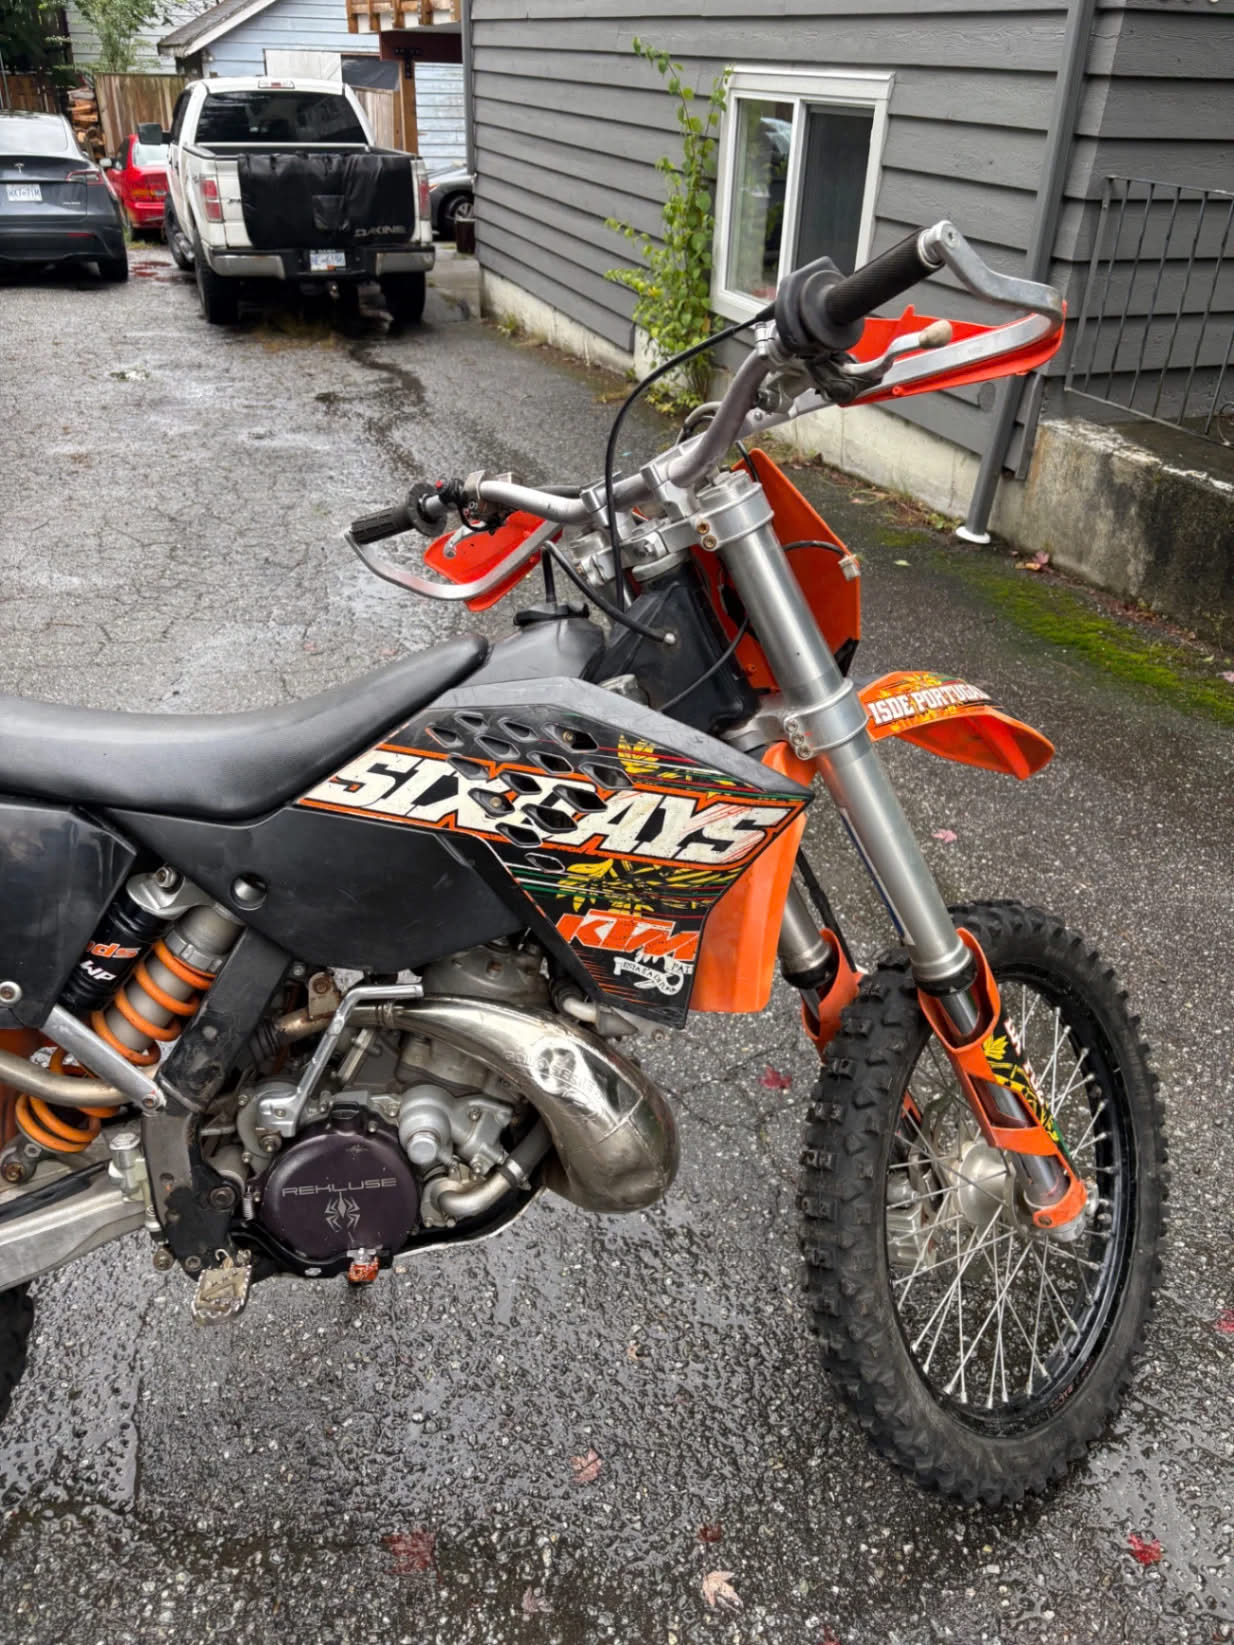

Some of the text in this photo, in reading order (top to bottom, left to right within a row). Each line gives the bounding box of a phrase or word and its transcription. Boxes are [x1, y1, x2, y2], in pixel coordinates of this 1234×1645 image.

[911, 684, 991, 712] PORTUGA
[555, 909, 700, 961] KTM
[80, 960, 117, 980] WP
[282, 1178, 397, 1197] REKLUSE
